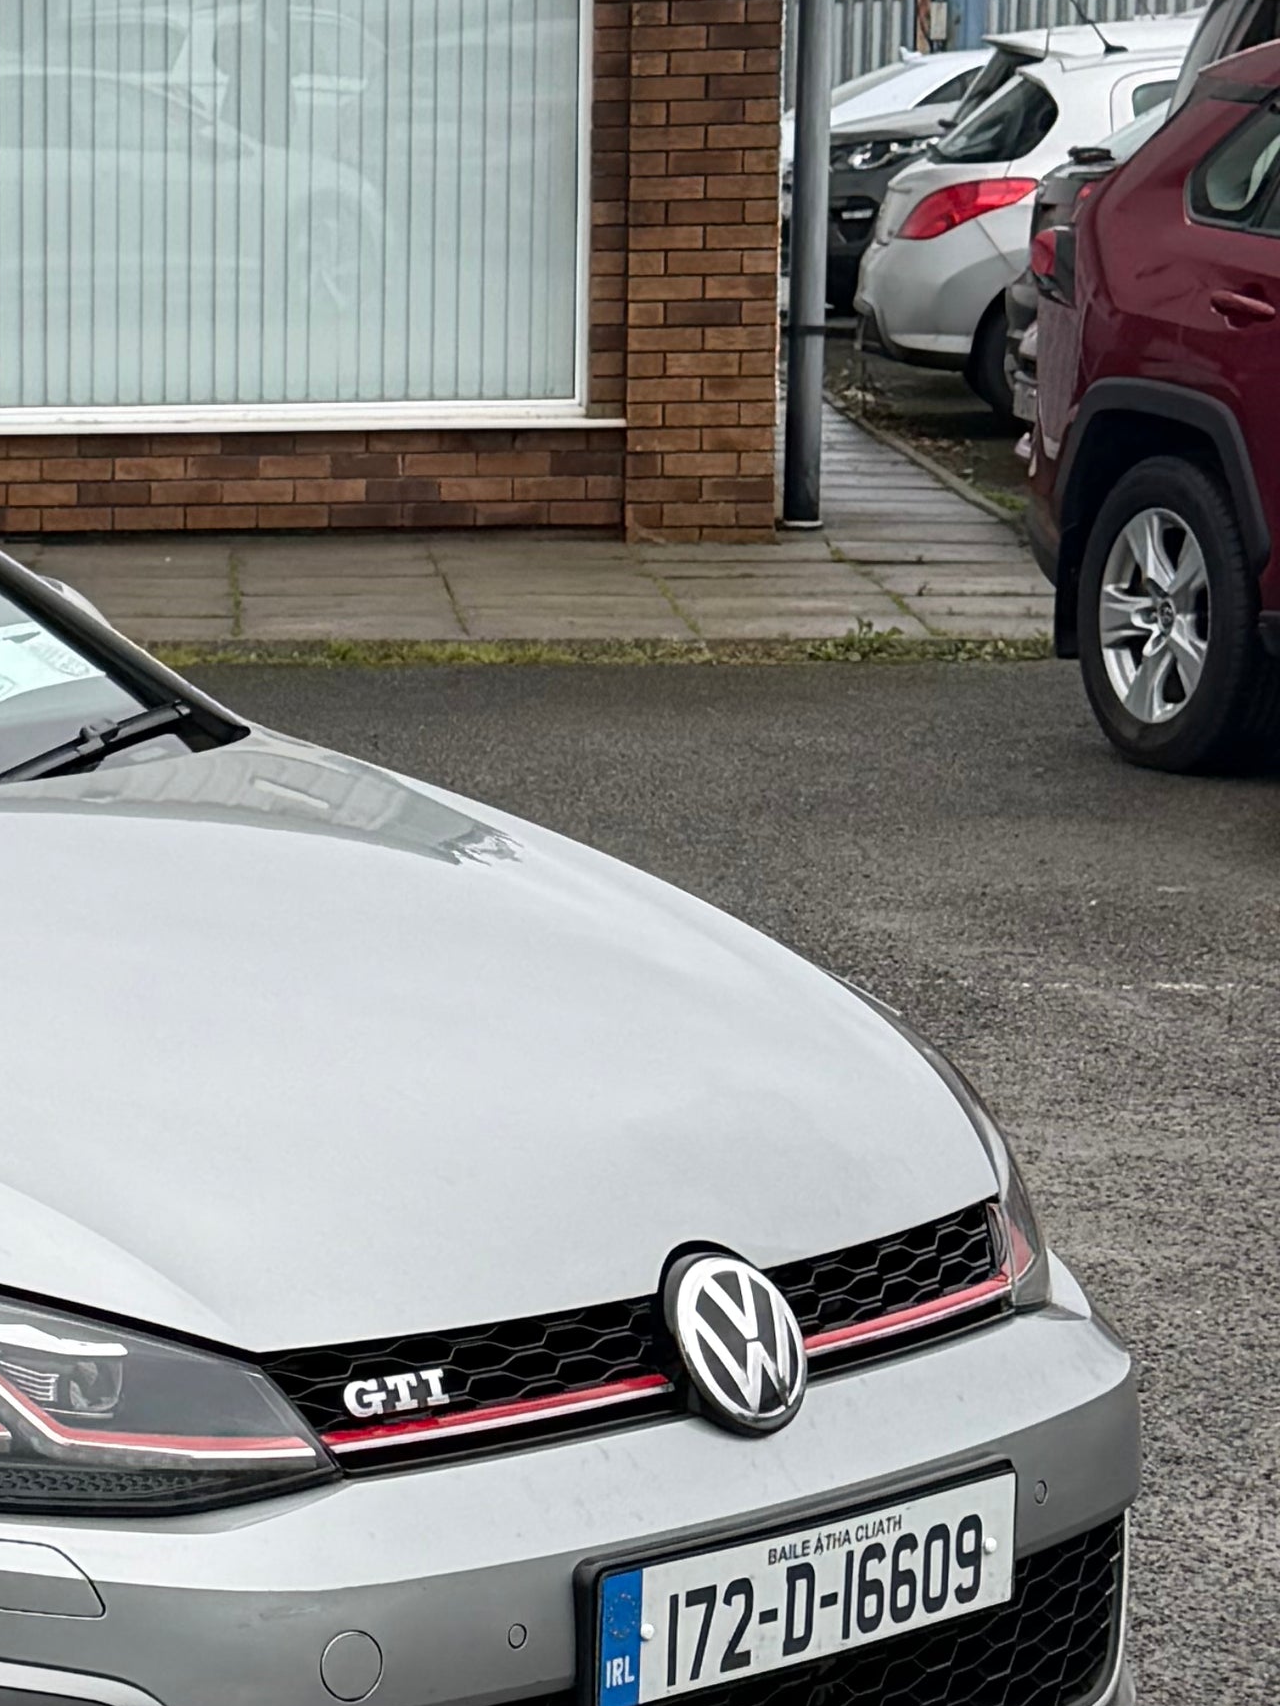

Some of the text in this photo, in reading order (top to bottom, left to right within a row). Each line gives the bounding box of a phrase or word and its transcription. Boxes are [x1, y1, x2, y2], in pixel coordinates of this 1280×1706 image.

[343, 1368, 451, 1418] GTI
[767, 1539, 811, 1566] BAILE
[855, 1514, 903, 1543] CLIATH
[666, 1513, 984, 1687] 172-D-16609
[605, 1656, 635, 1690] IRL
